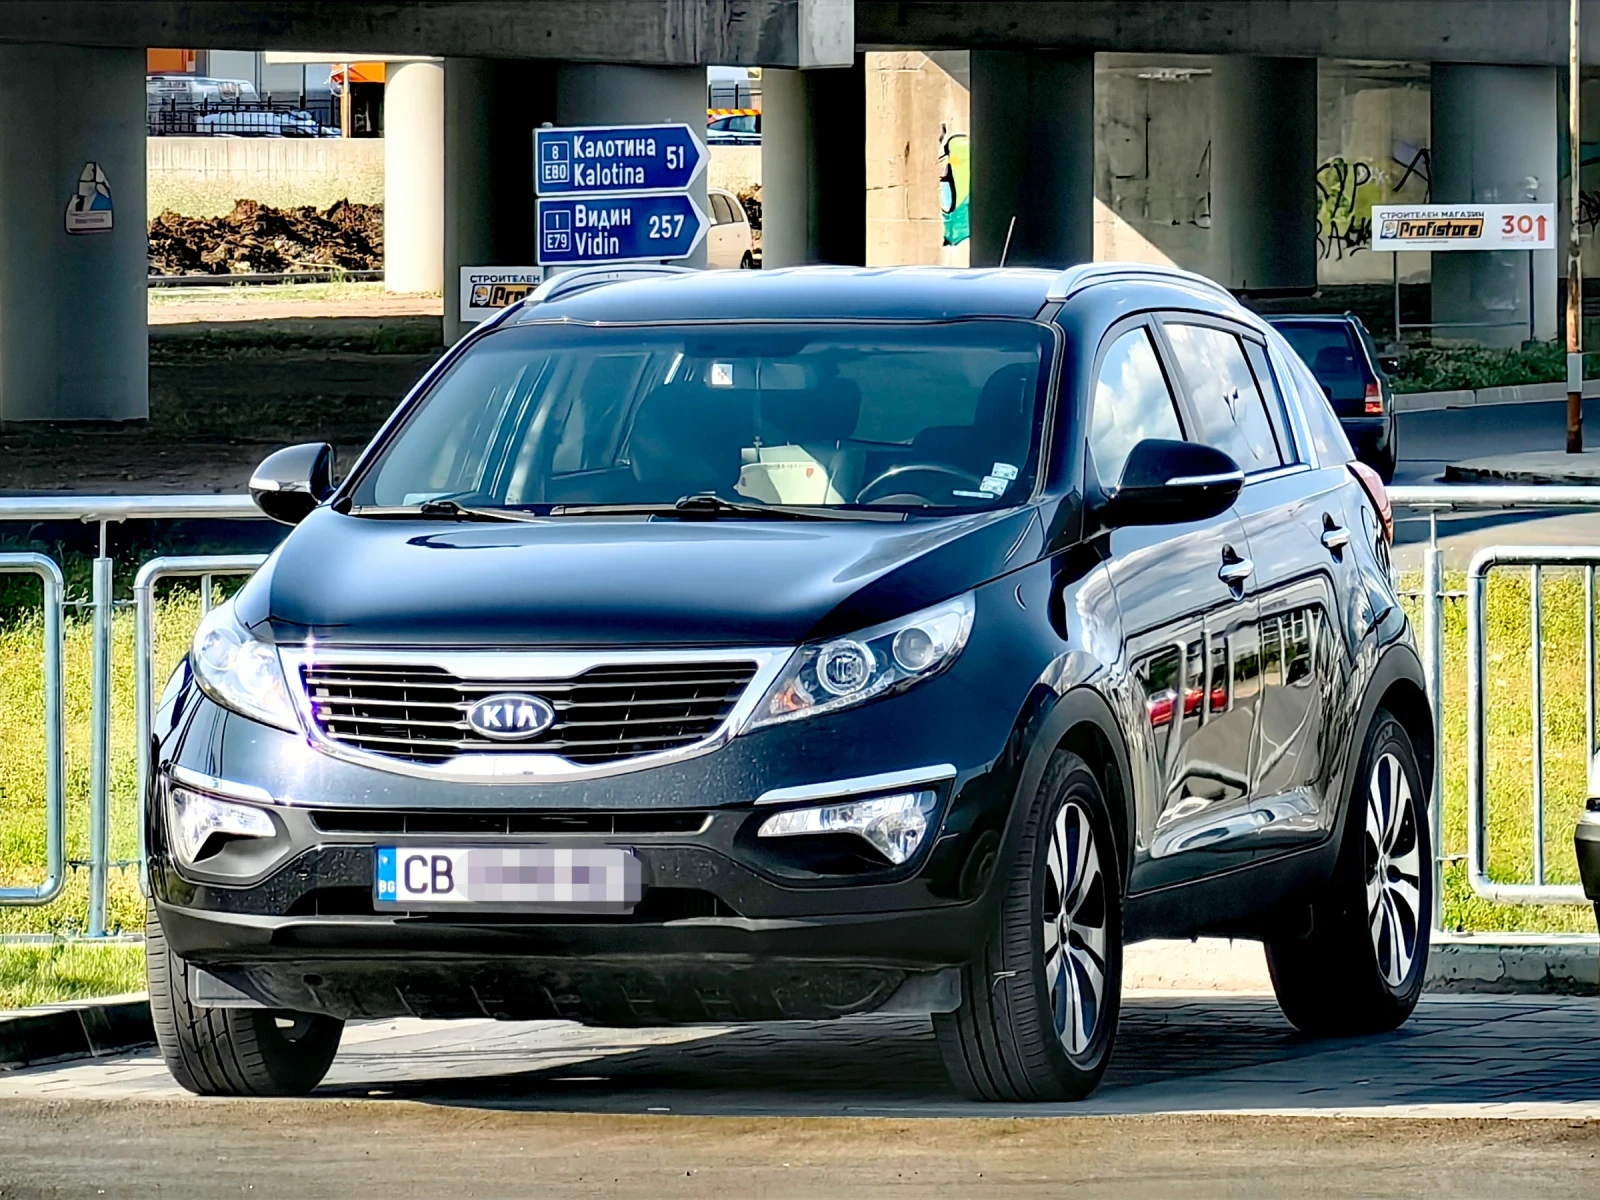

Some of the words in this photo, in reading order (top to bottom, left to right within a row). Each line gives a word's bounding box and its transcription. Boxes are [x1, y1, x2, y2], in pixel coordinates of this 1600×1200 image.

[551, 145, 559, 160] 8
[573, 135, 656, 159] Калотина
[666, 146, 684, 170] 51
[545, 164, 567, 179] E80
[574, 163, 645, 187] Kalotina
[575, 203, 631, 230] Видин
[649, 214, 685, 239] 257
[1501, 214, 1534, 234] 30
[547, 233, 568, 249] E79
[1399, 221, 1479, 237] Profistore
[574, 231, 620, 256] Vidin
[469, 274, 541, 283] СТРОИТЕЛЕН
[482, 703, 538, 728] KIA
[379, 880, 396, 893] BG
[404, 854, 455, 895] CB
